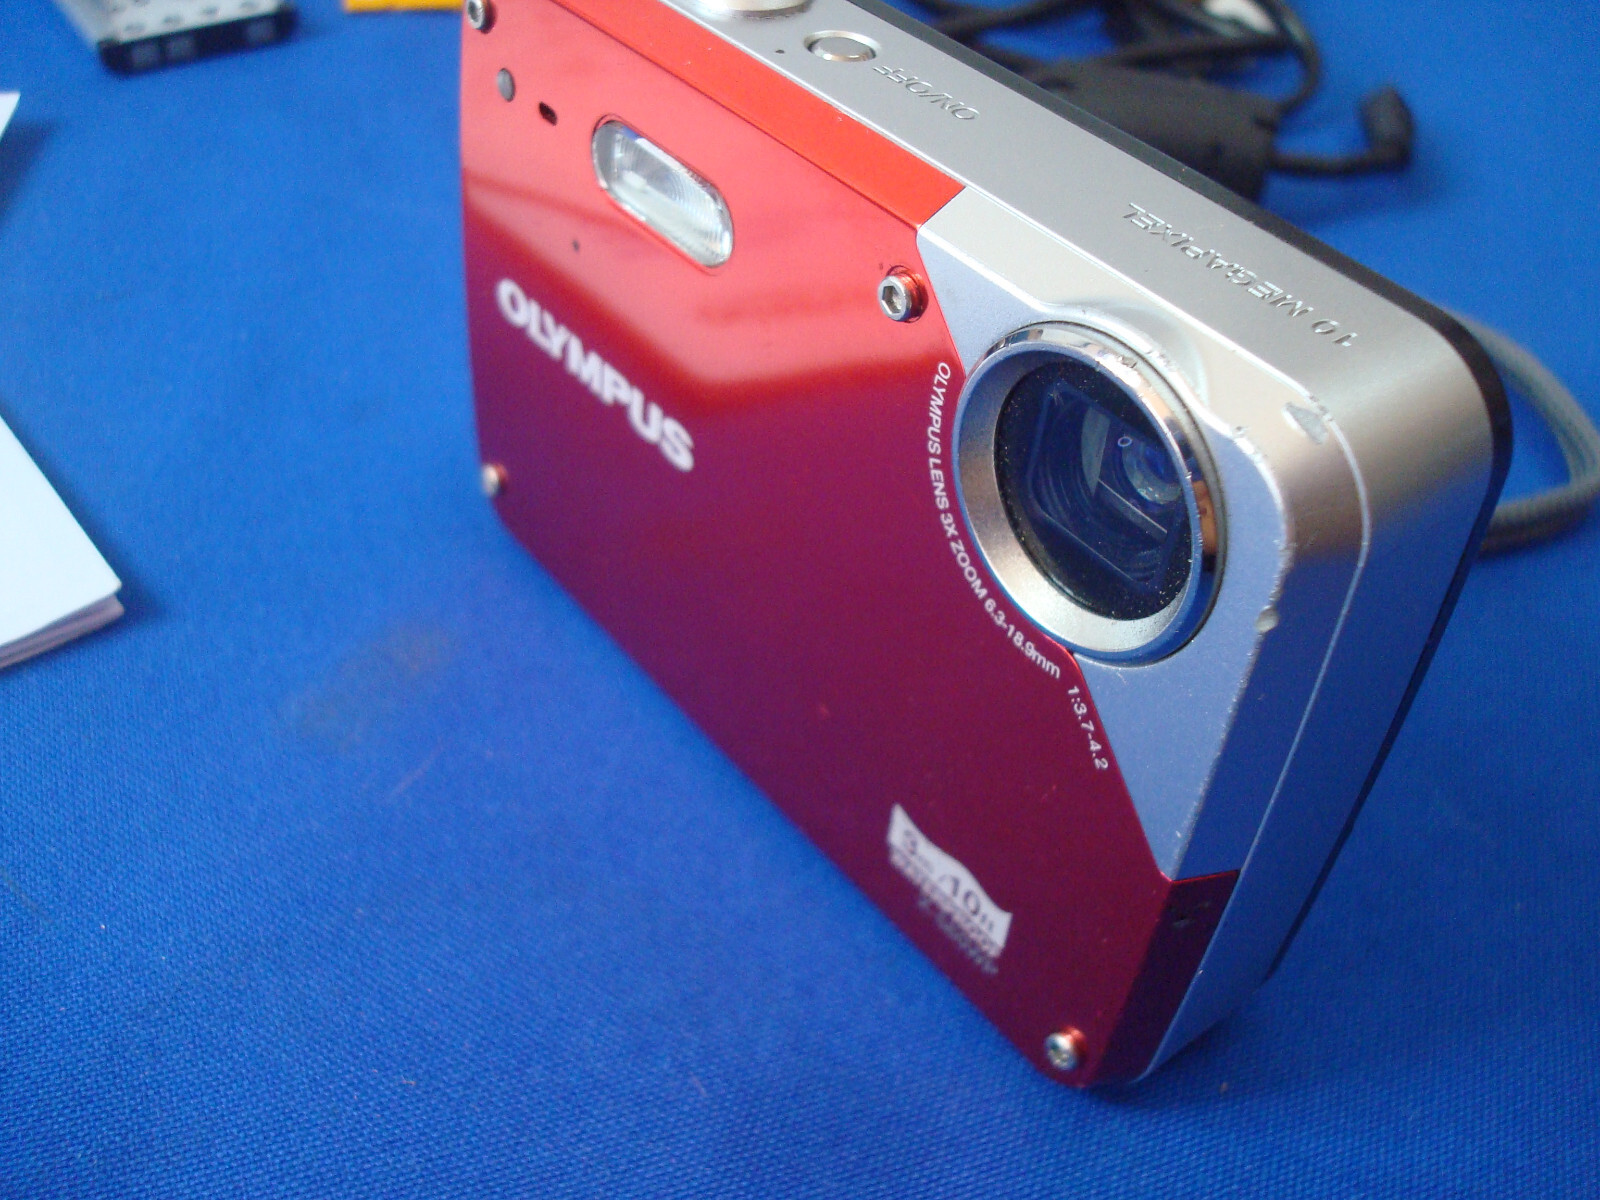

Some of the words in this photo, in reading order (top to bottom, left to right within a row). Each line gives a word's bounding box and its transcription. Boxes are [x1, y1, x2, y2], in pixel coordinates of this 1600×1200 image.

[873, 65, 979, 120] ON/OFF
[1123, 202, 1314, 317] MEGAPIXEL
[1311, 318, 1358, 347] 10
[495, 277, 694, 472] OLYMPUS
[927, 362, 951, 455] OLYMPUS
[929, 456, 949, 510] LENS
[940, 512, 958, 538] 3X
[951, 539, 988, 599] ZOOM
[984, 598, 1061, 679] 6.3-18.9mm
[1068, 685, 1108, 769] 1:3.7-4.2
